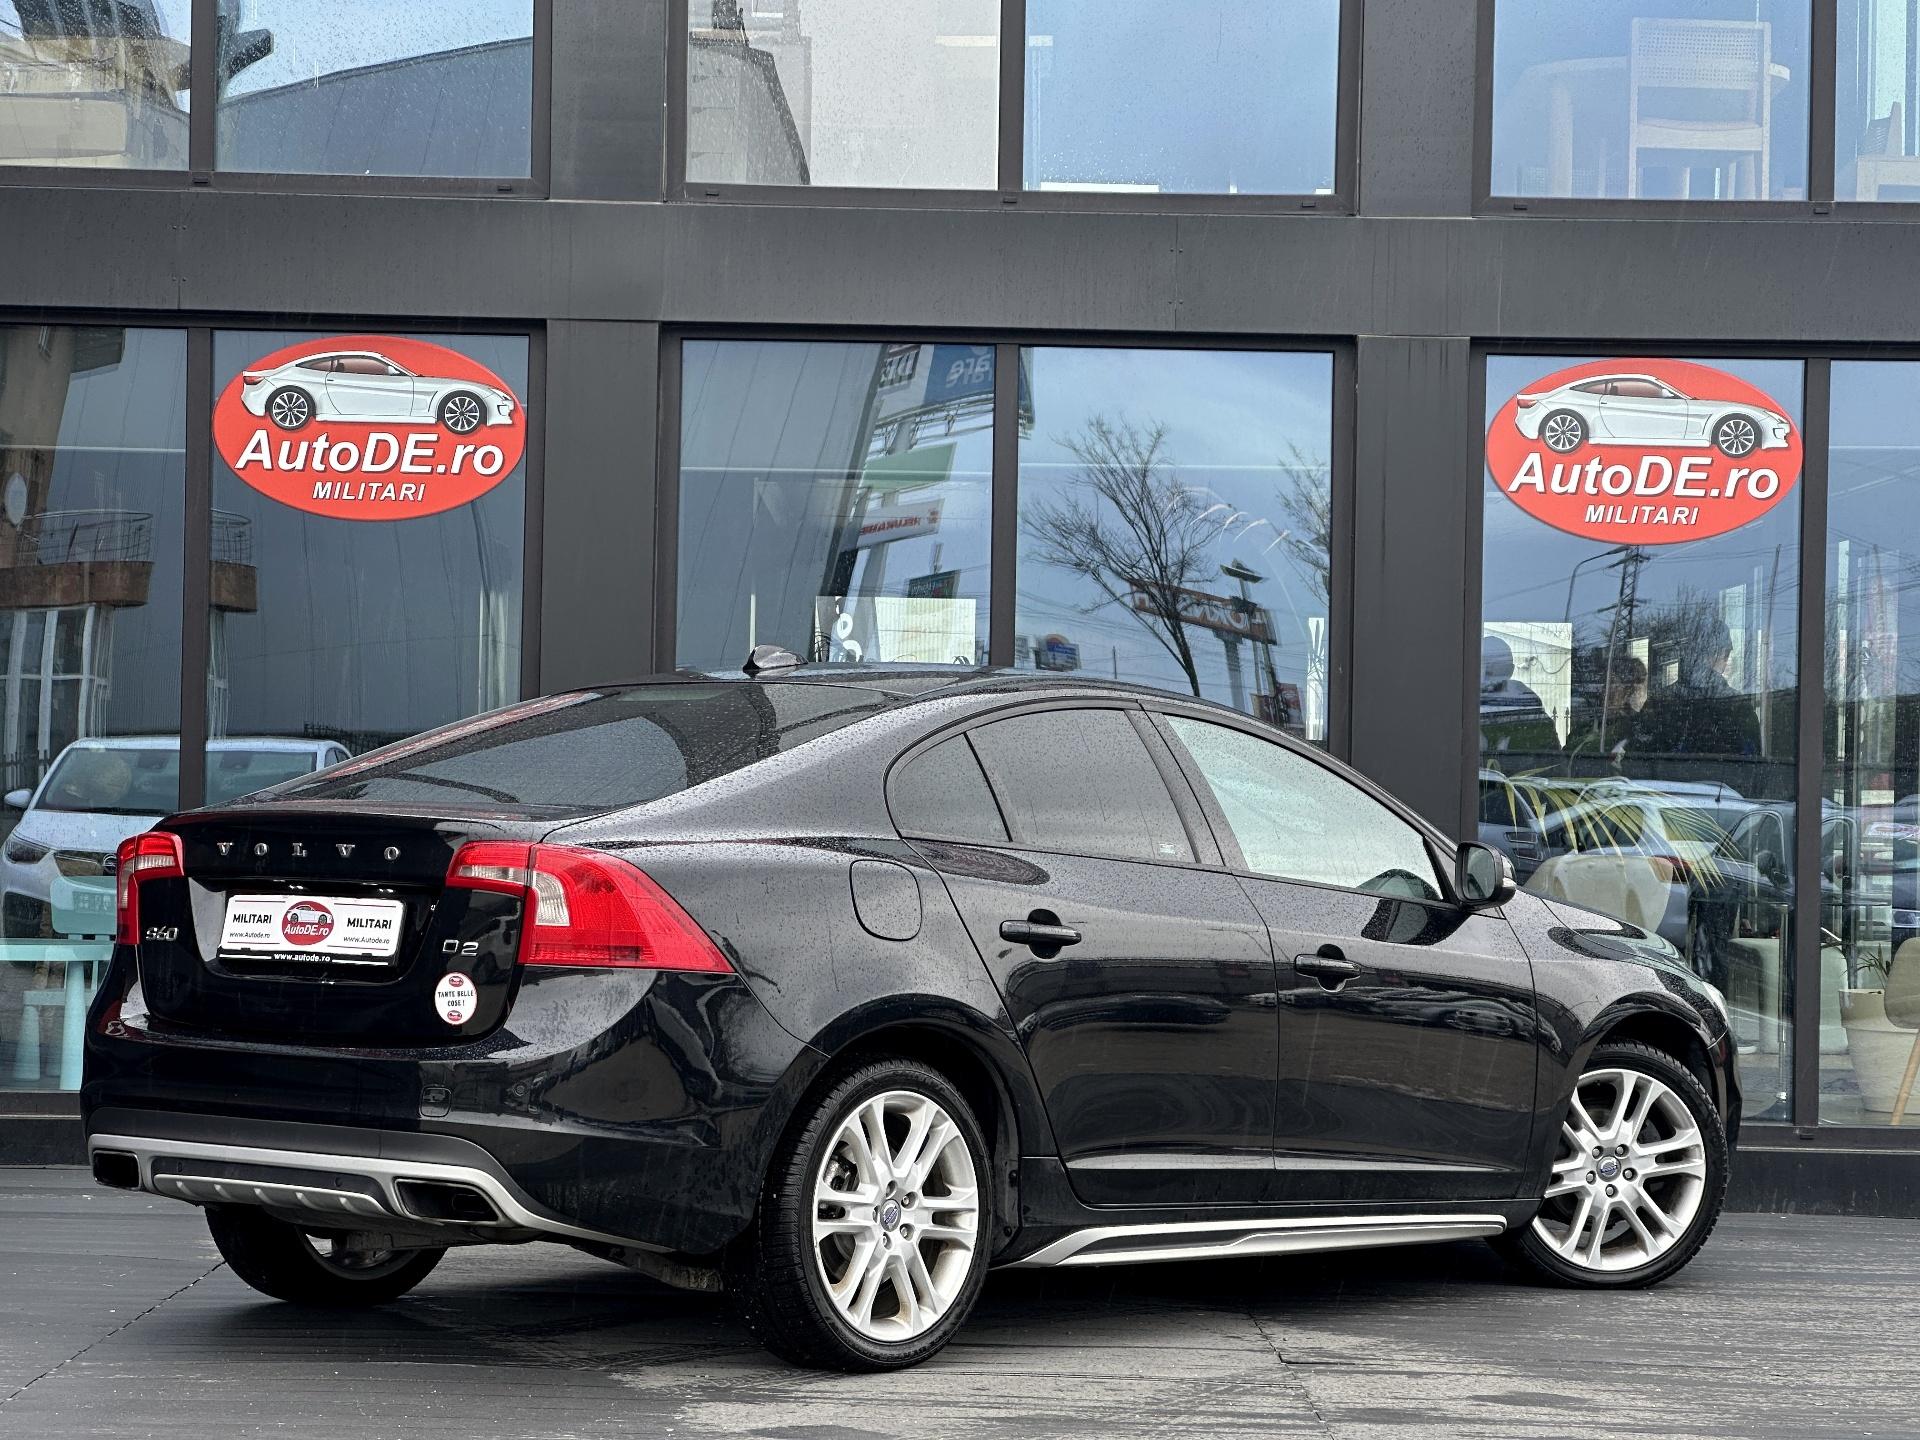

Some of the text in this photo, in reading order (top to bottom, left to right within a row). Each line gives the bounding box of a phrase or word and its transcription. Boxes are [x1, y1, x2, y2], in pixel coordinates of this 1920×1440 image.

[235, 429, 505, 475] AutoDE.ro
[1508, 452, 1780, 500] AutoDE.ro
[312, 481, 426, 501] MILITARI
[1584, 504, 1700, 525] MILITARI
[217, 842, 400, 861] VOLVO
[232, 913, 272, 924] MILITARI
[346, 917, 393, 930] MILITARI
[146, 925, 179, 941] S60
[229, 931, 271, 939] www.Autode.ro
[283, 924, 330, 936] AutoDE.ro
[343, 936, 391, 945] www.Autode.ro
[442, 939, 479, 957] D2
[273, 952, 331, 963] www.autode.ro
